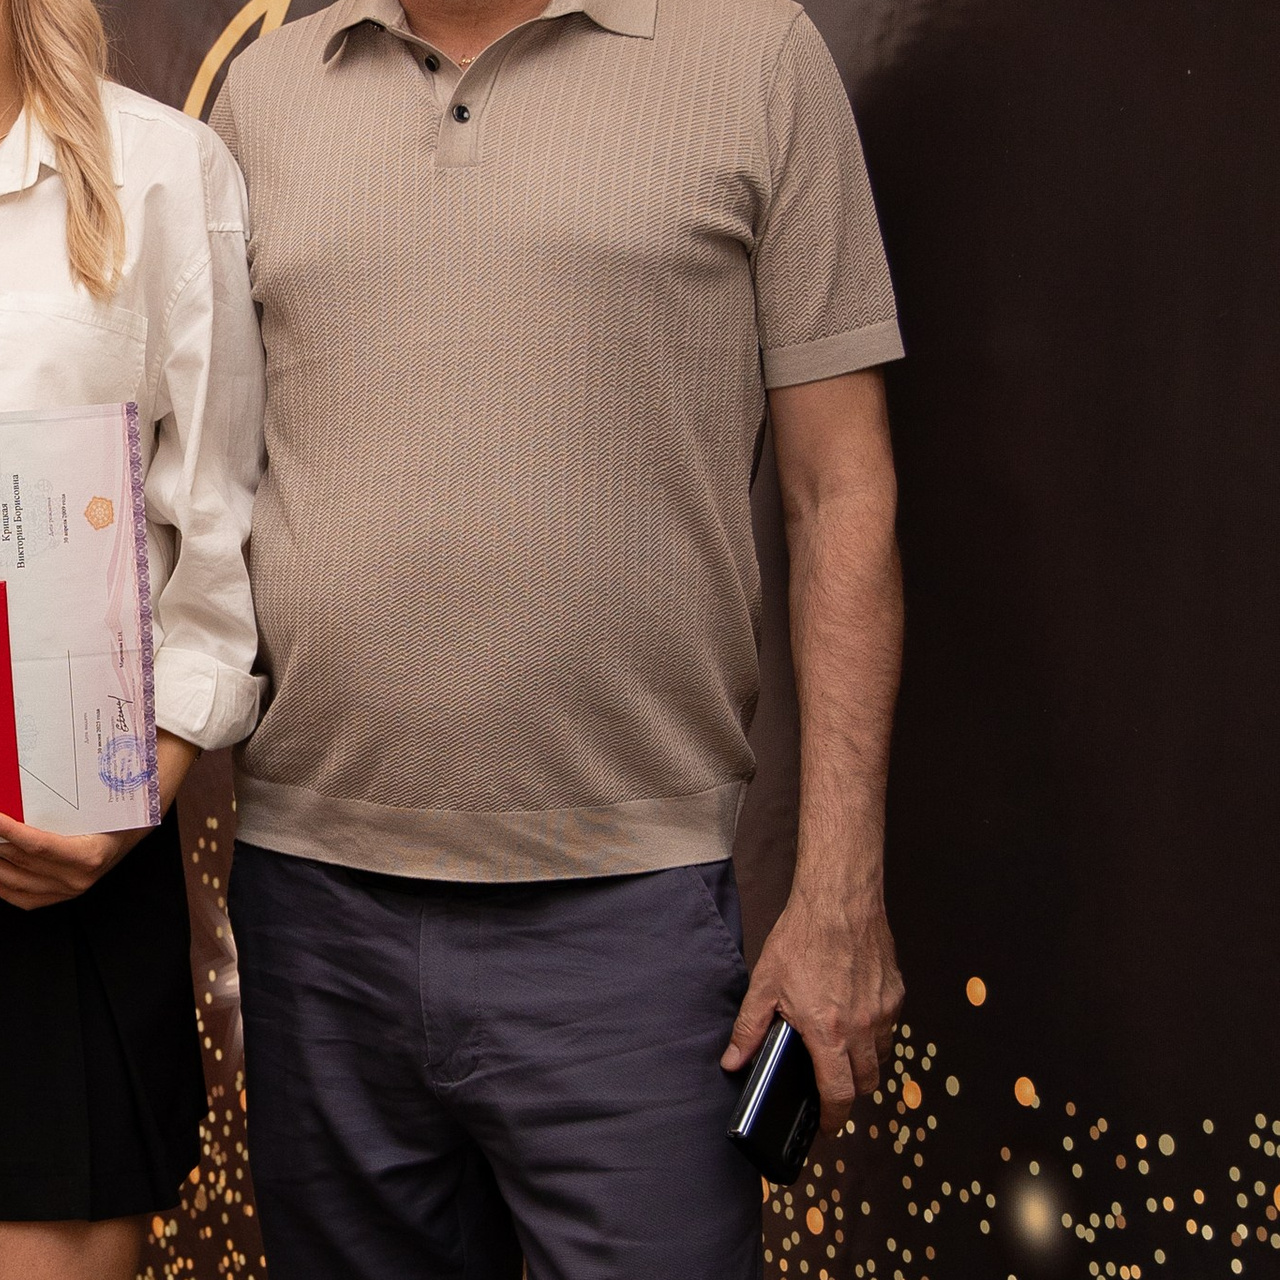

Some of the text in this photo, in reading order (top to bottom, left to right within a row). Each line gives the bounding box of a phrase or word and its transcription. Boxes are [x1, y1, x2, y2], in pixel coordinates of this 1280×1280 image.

[1, 503, 12, 542] Крицкая
[12, 474, 26, 569] Виктория Борисовна
